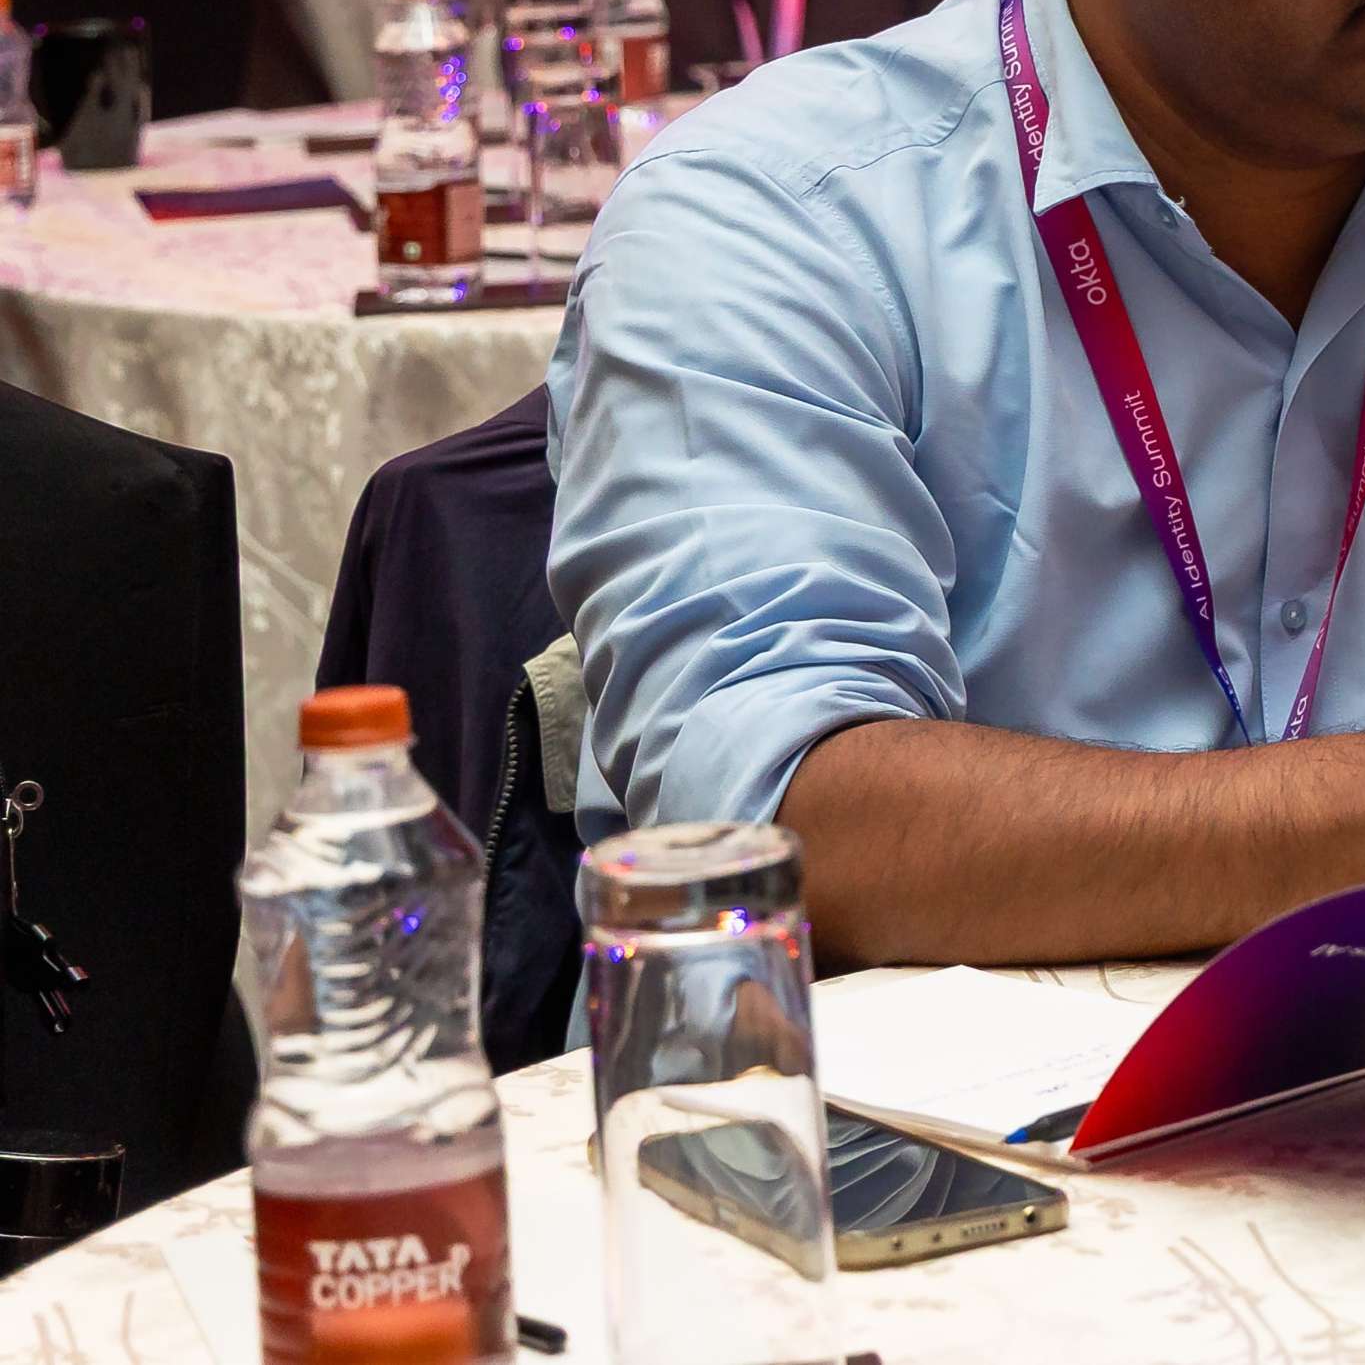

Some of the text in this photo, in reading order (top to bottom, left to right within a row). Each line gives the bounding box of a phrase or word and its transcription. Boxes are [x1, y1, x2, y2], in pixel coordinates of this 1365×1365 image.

[1068, 237, 1107, 305] okta
[1124, 389, 1210, 620] AI Identity Summit
[1287, 694, 1309, 741] kta
[308, 1235, 430, 1273] TATA
[311, 1243, 472, 1309] COPPER
